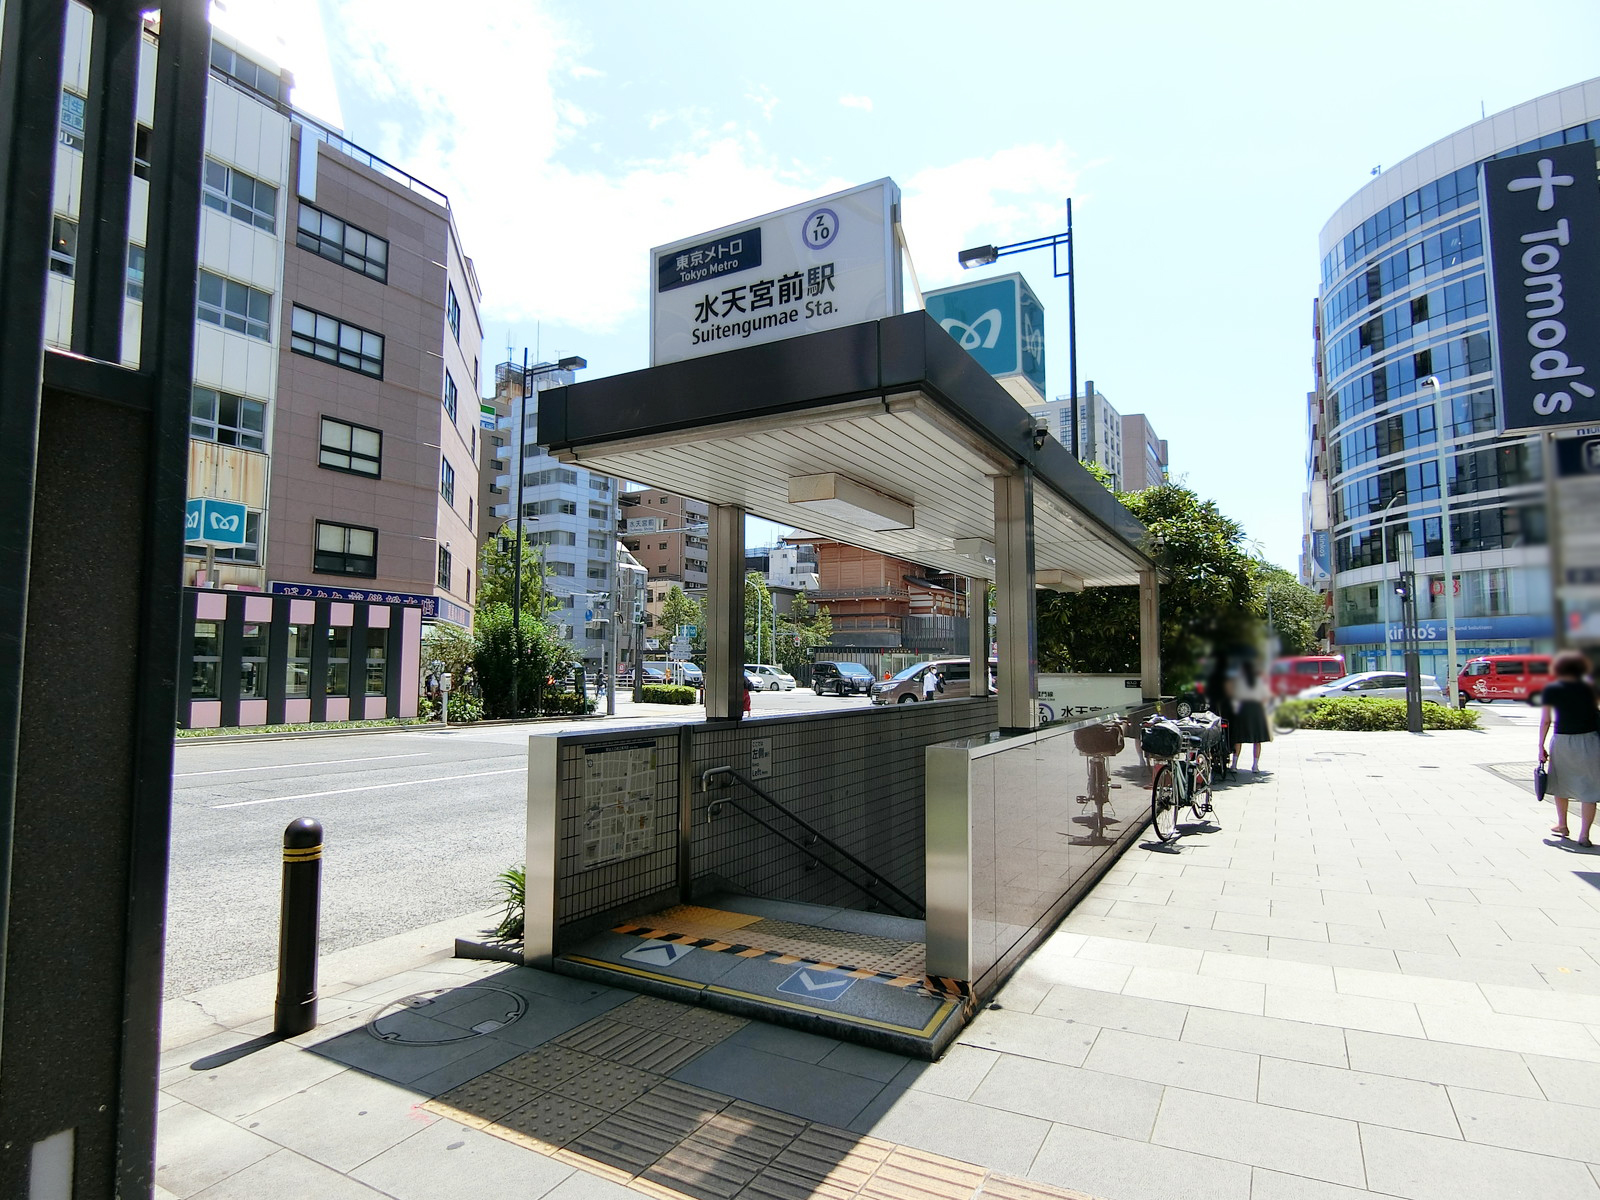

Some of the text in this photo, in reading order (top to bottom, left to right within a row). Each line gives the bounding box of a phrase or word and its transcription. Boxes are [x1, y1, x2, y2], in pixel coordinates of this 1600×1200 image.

[813, 227, 830, 241] 10
[816, 215, 825, 228] Z
[675, 239, 743, 271] 東京メトロ
[680, 259, 739, 282] Tokyo Metro
[695, 262, 836, 324] 水天宮前駅
[692, 300, 838, 345] Suitengumae Sta.
[1520, 218, 1596, 416] Tomod's
